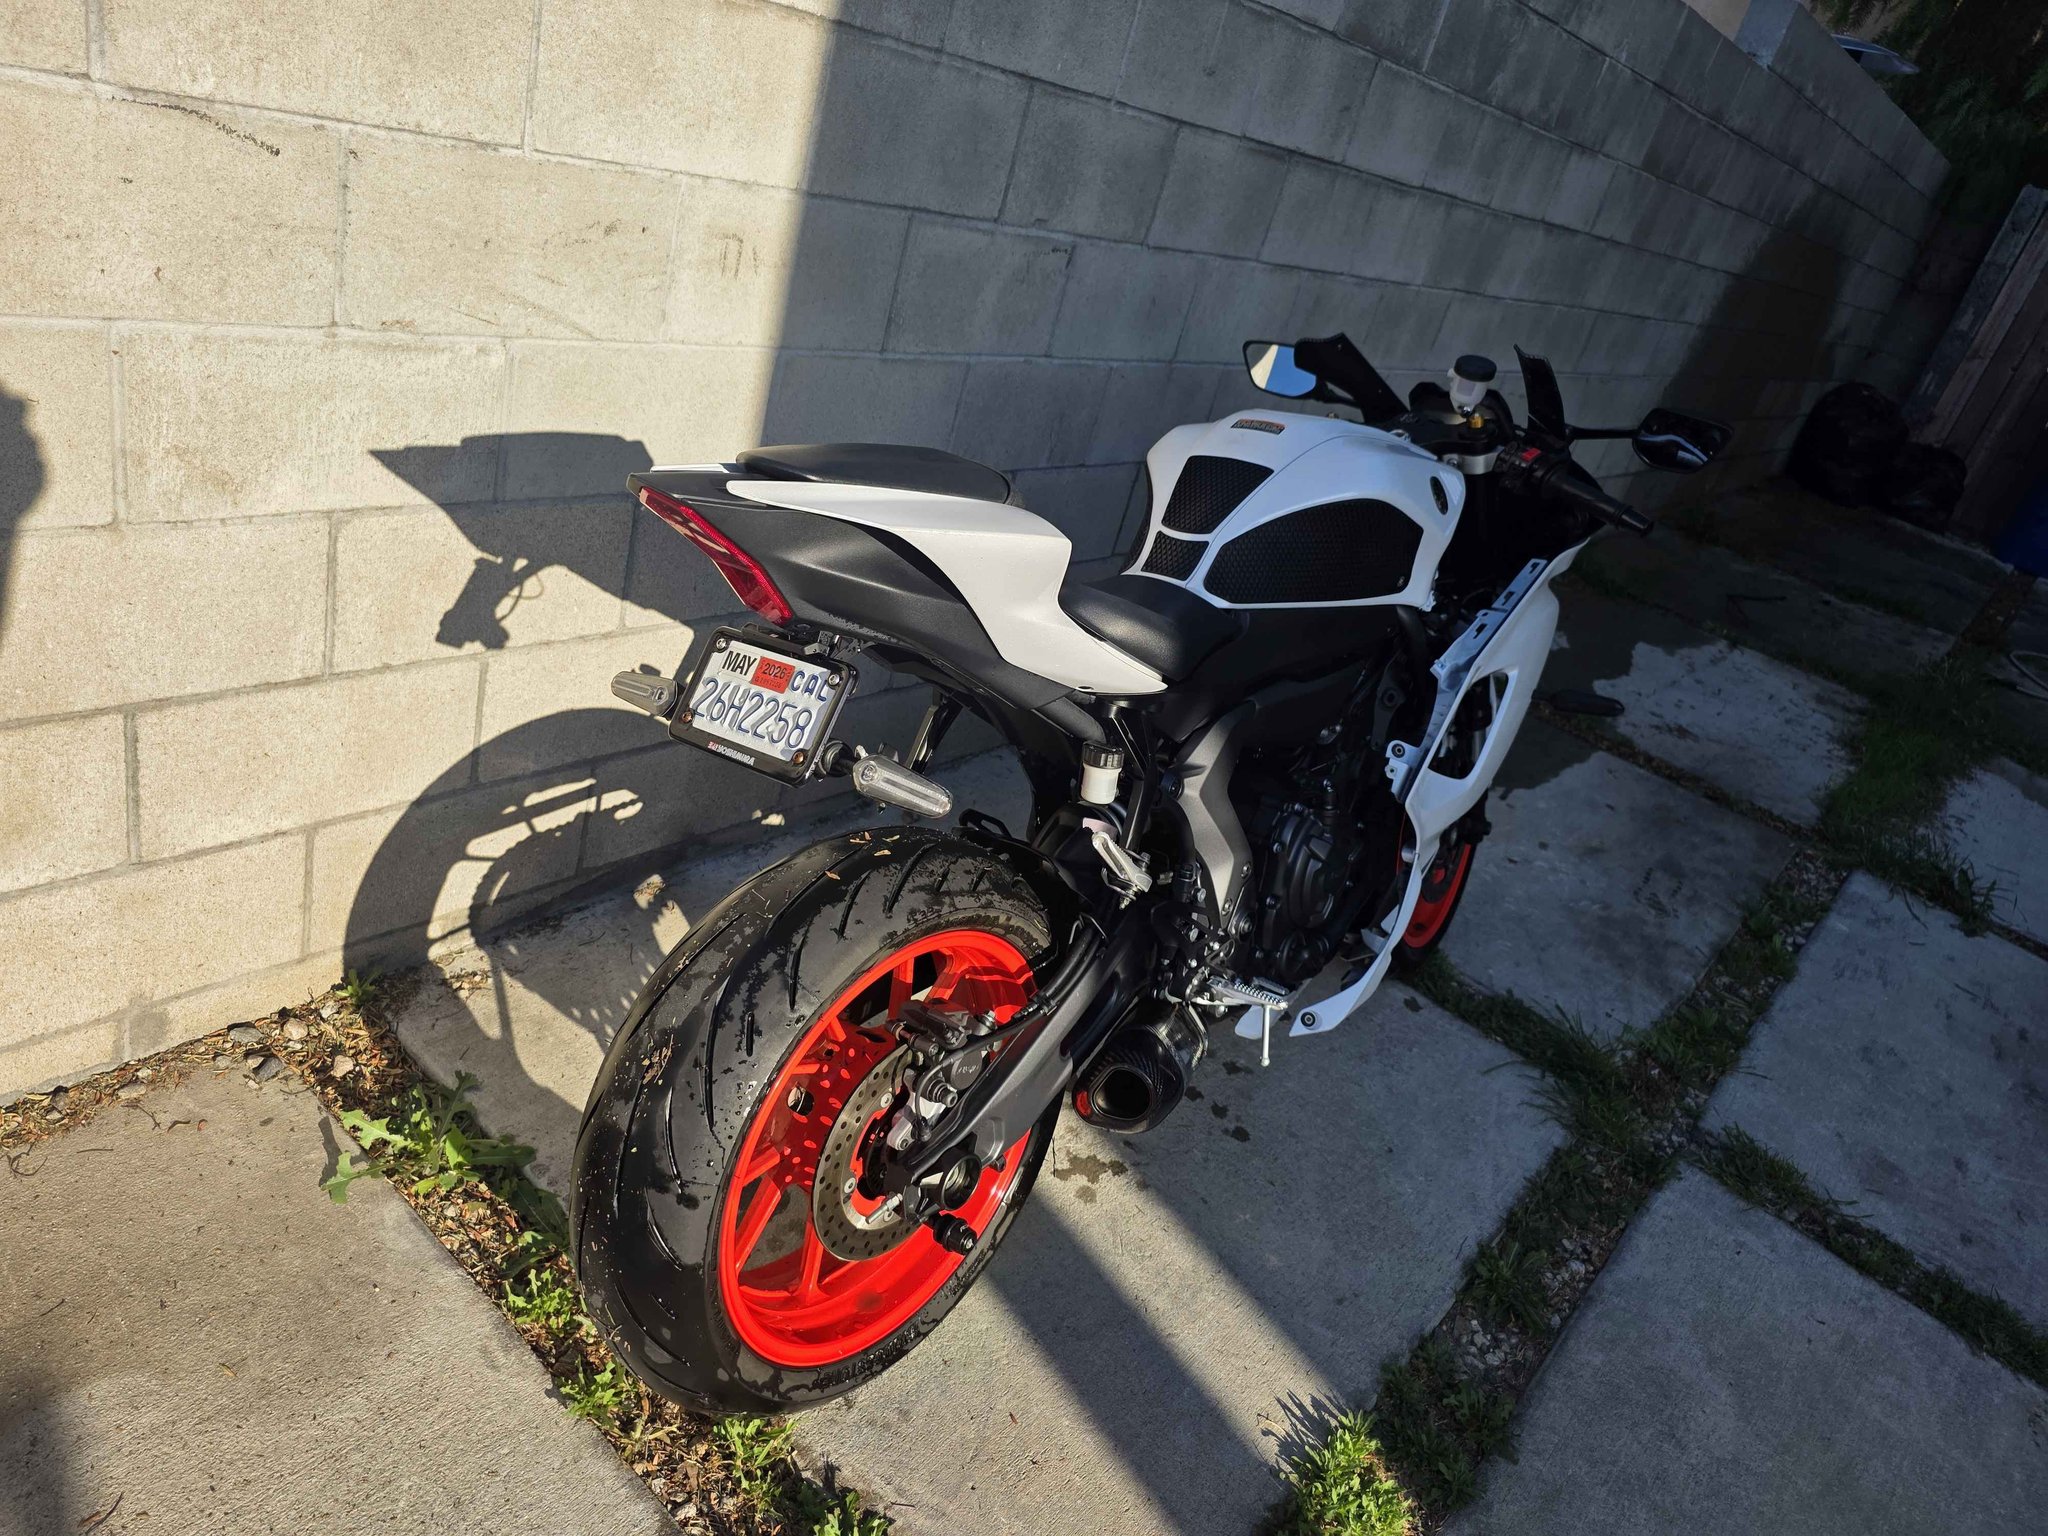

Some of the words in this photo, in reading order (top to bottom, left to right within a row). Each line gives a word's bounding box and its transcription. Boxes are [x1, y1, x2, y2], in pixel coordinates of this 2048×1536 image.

[722, 650, 758, 676] MAY
[762, 662, 787, 680] 2026
[790, 669, 828, 702] CAL
[693, 677, 813, 749] 26H2258
